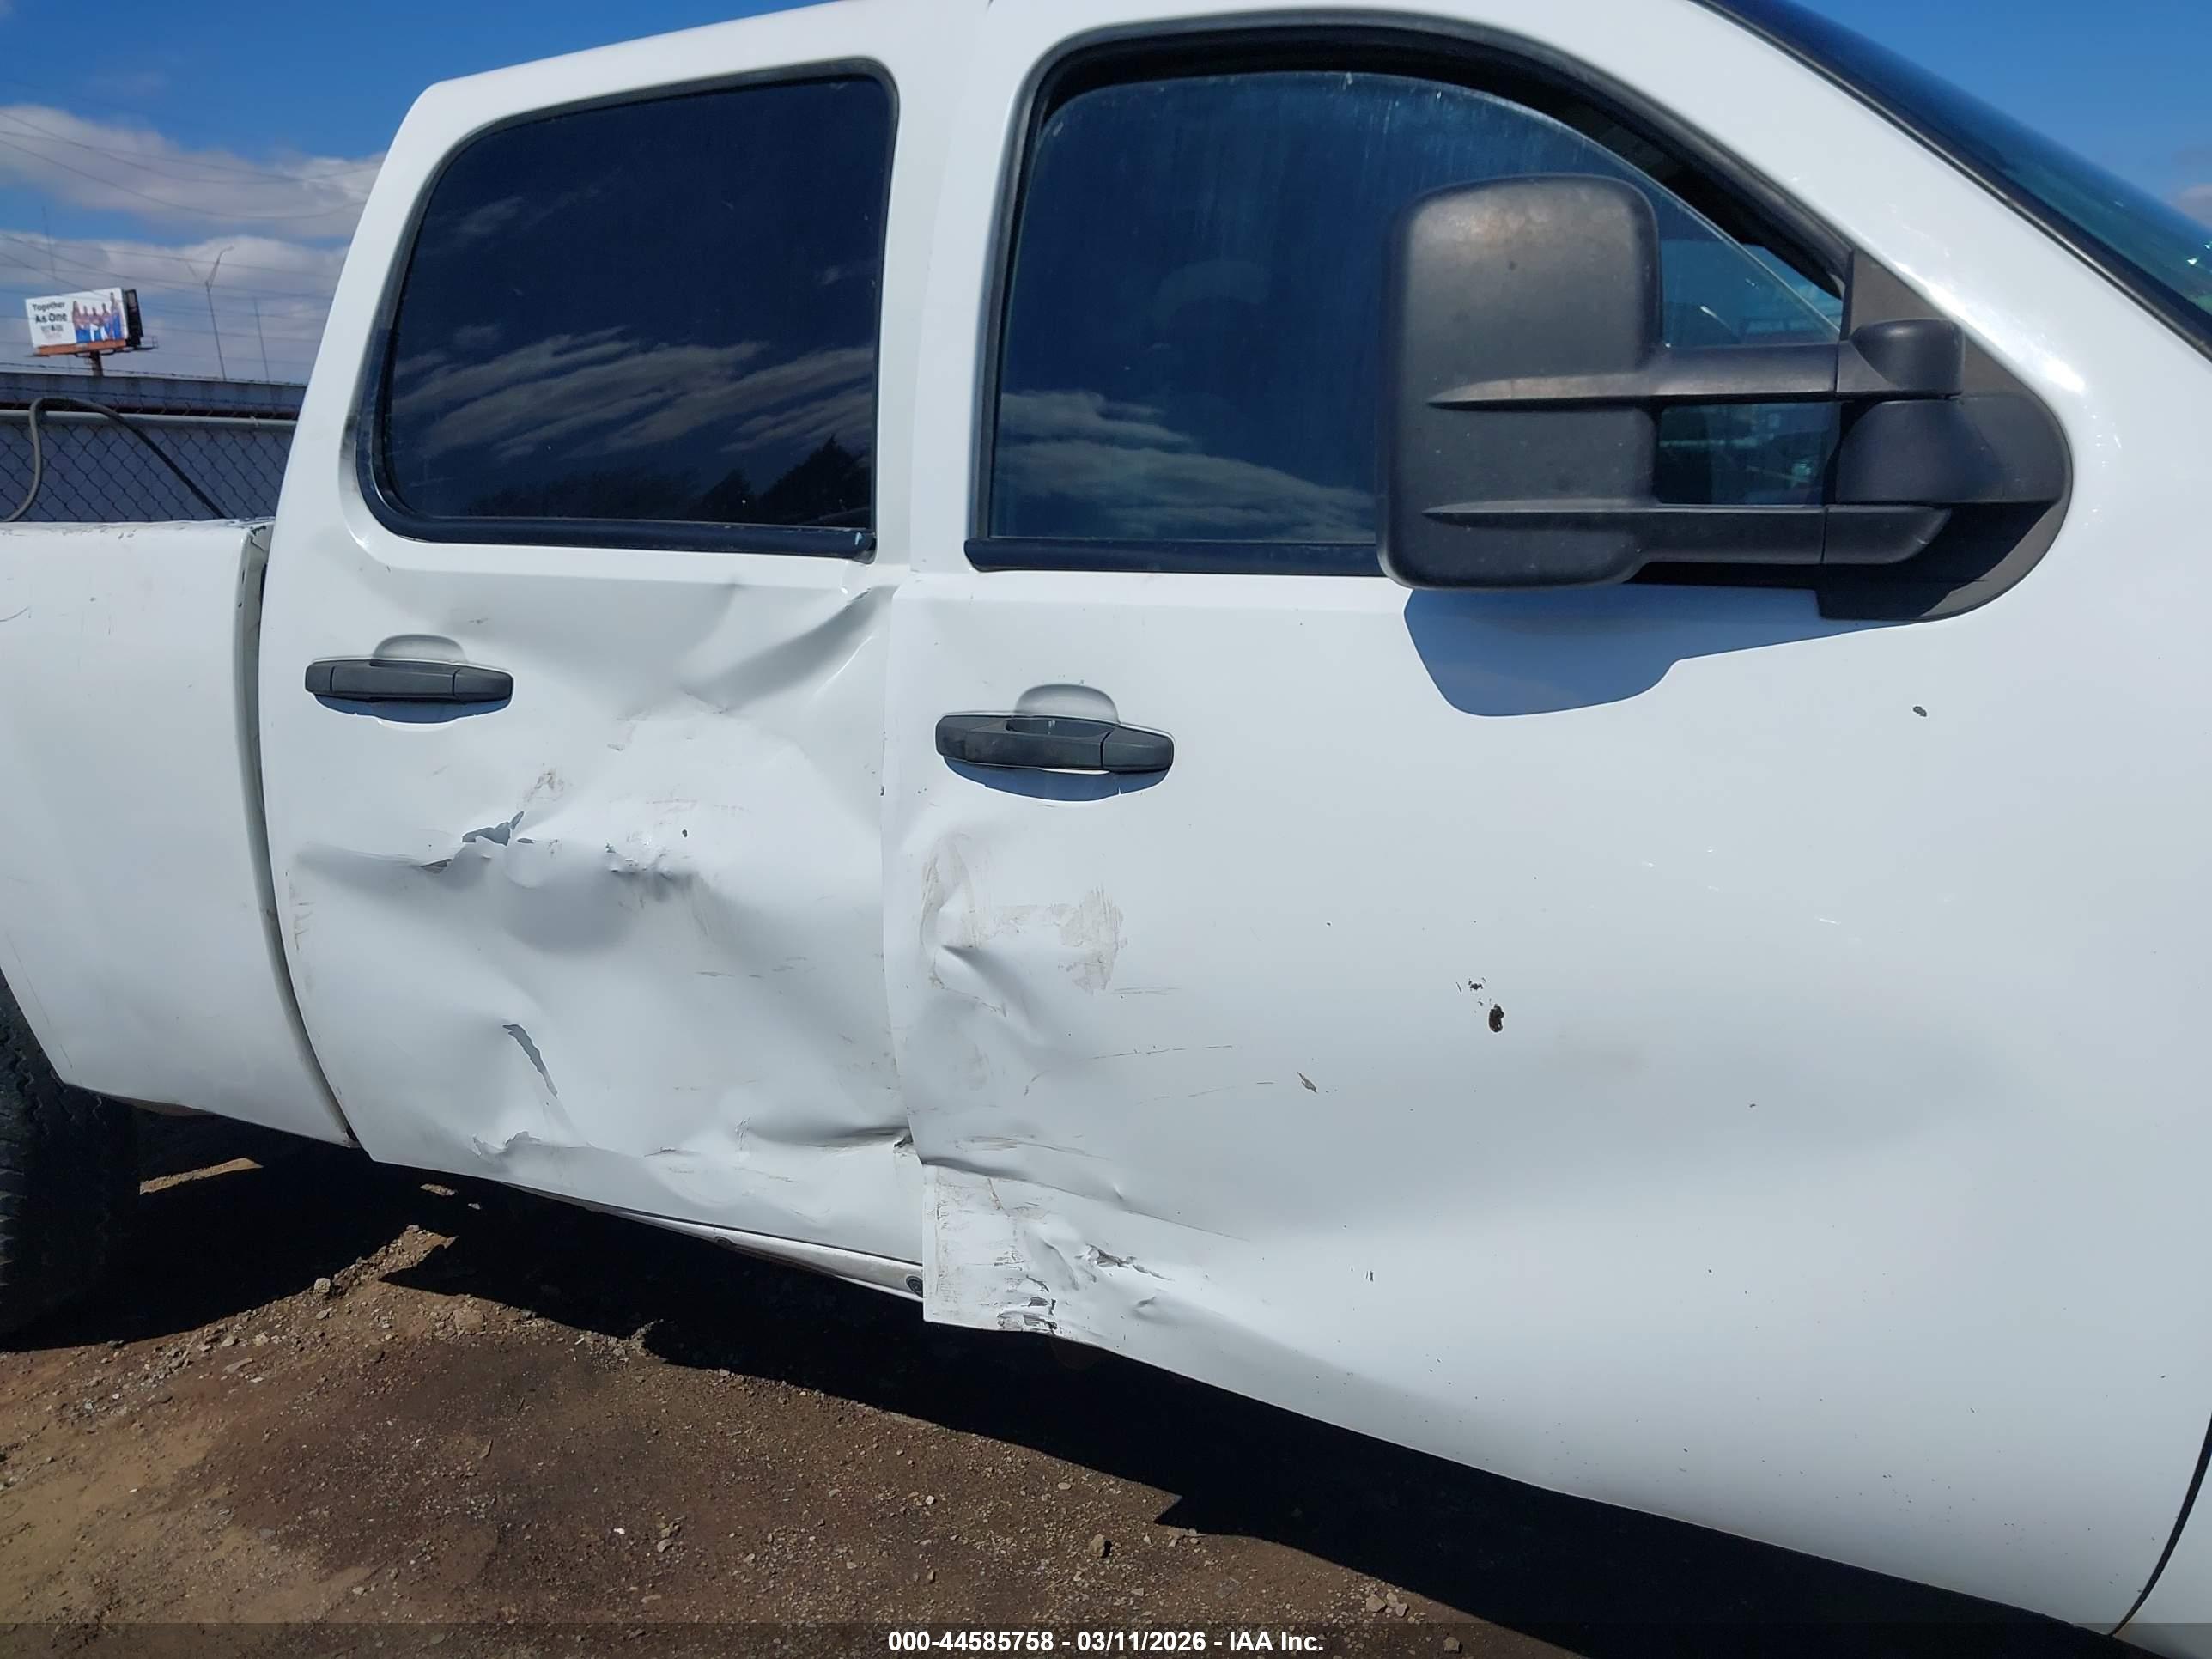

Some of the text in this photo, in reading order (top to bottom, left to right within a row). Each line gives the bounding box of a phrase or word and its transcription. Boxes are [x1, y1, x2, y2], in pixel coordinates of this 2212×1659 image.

[32, 301, 65, 312] Together
[35, 313, 68, 324] As One
